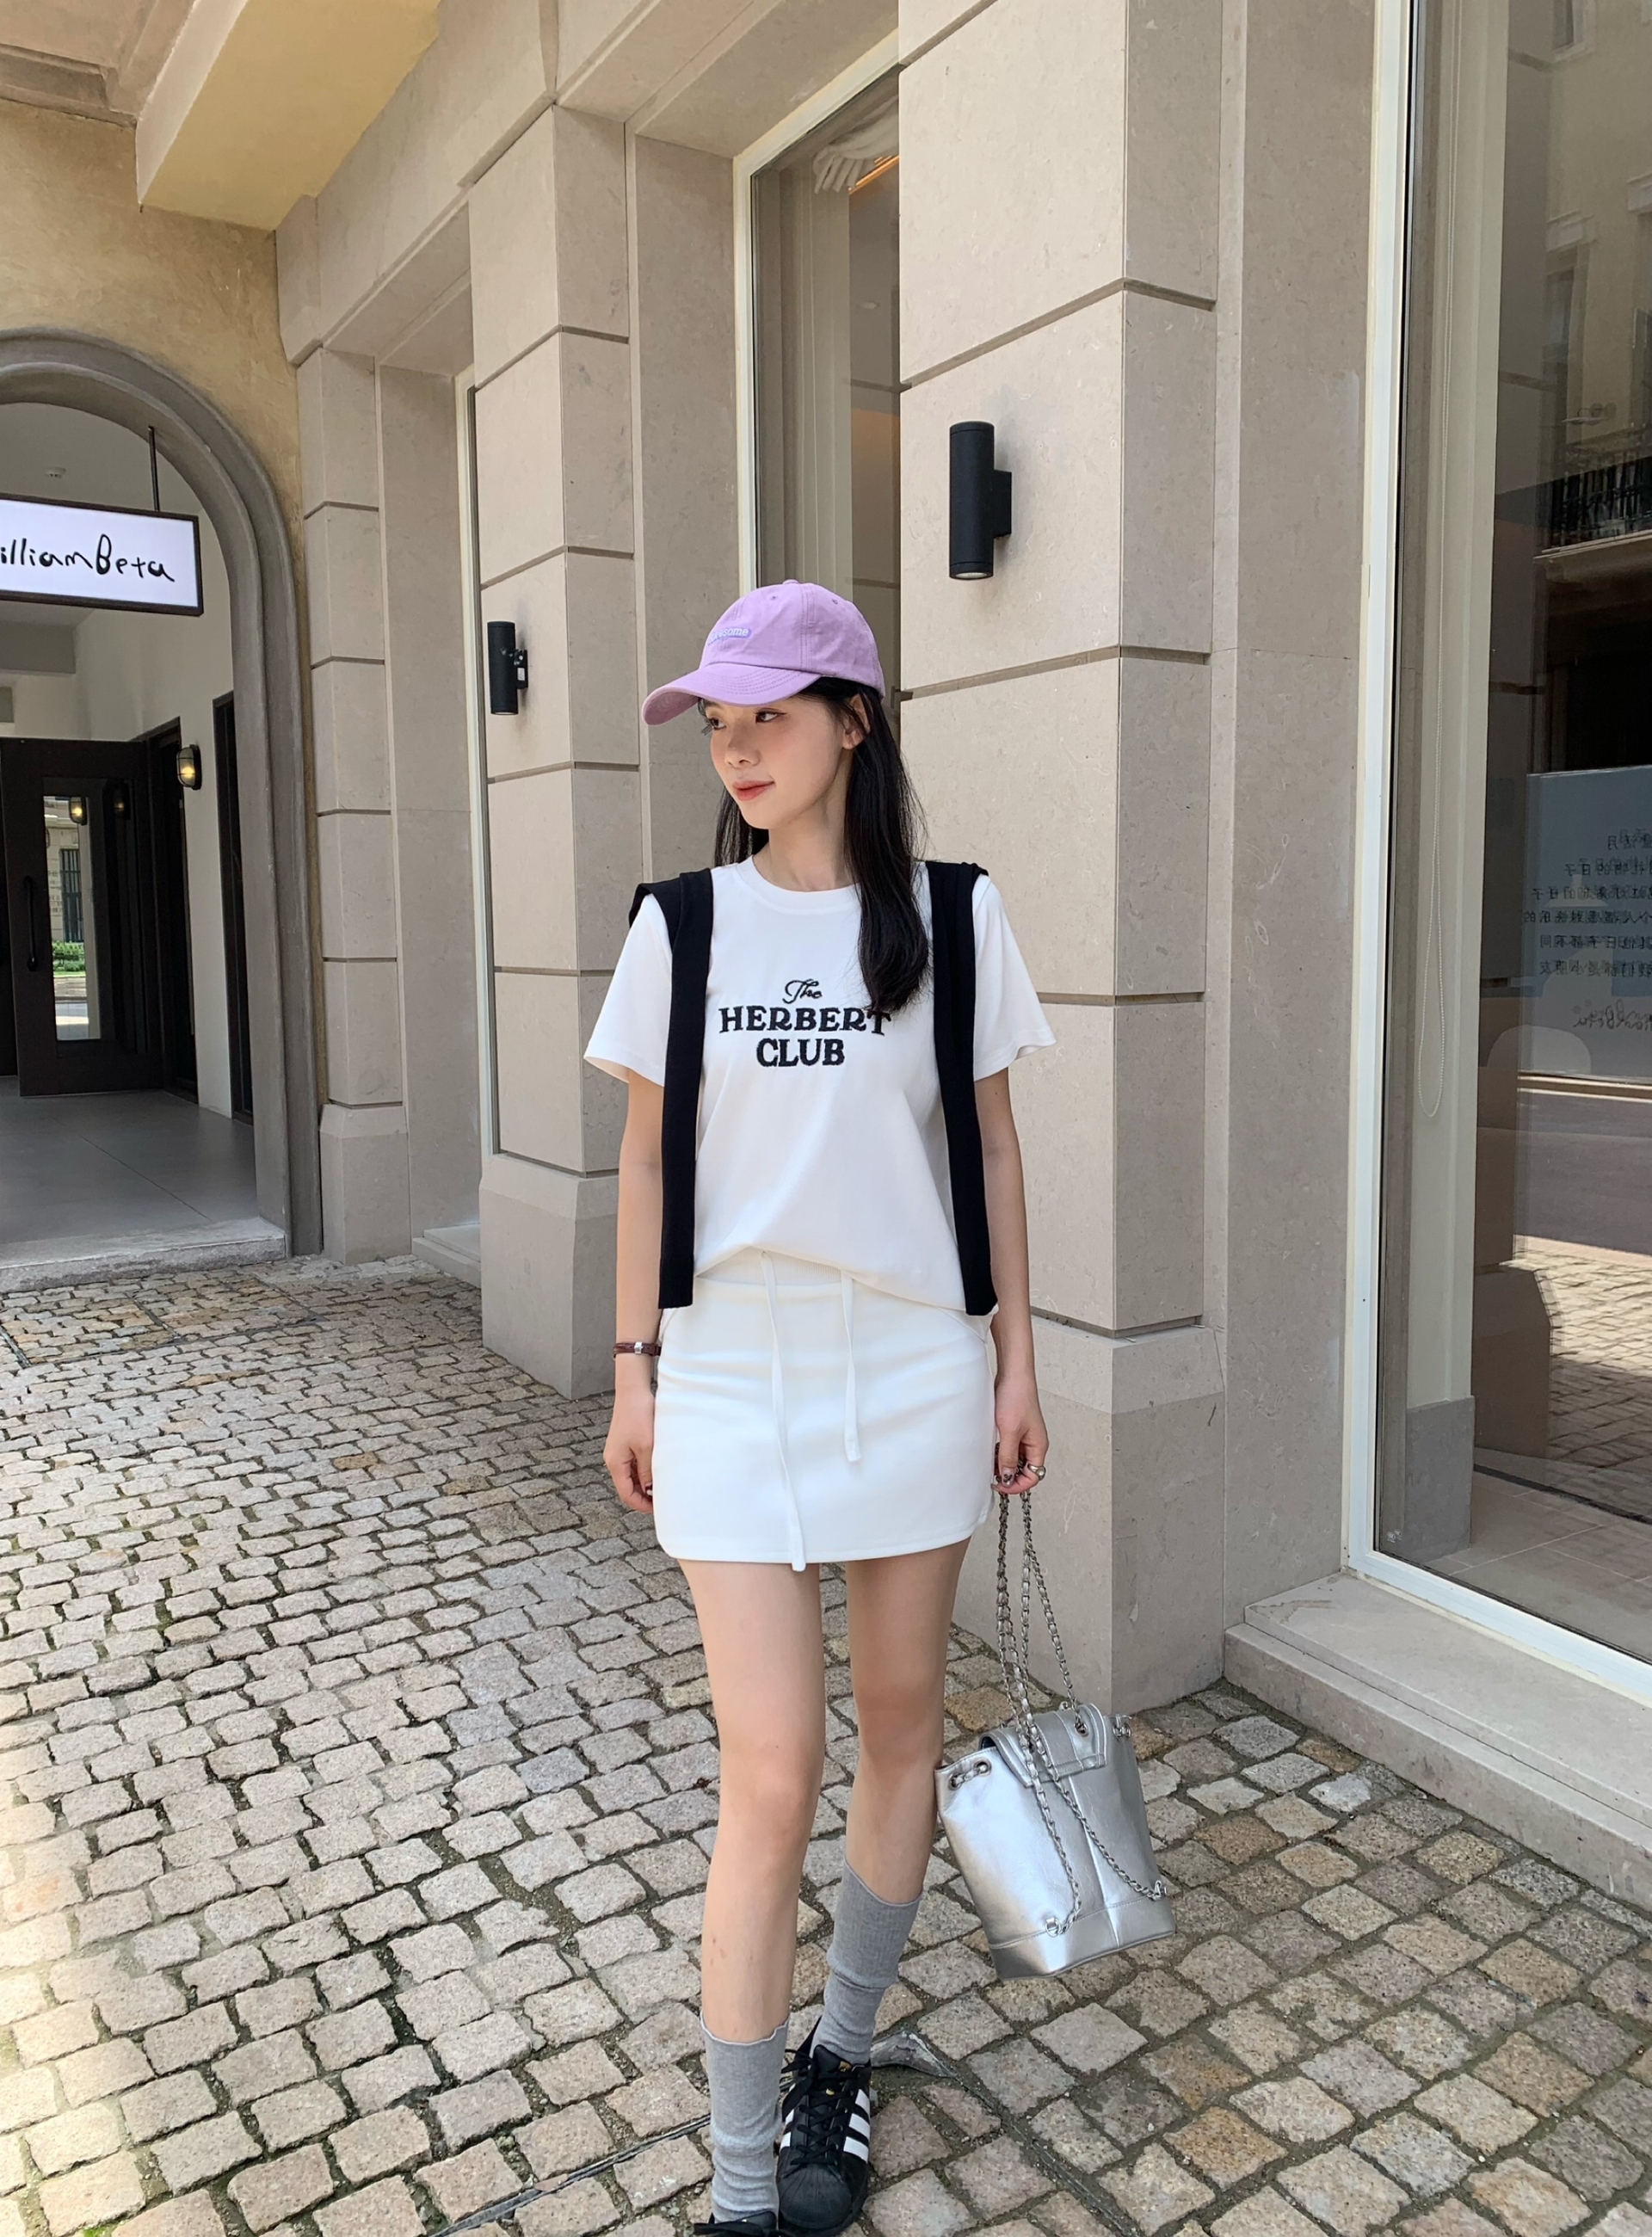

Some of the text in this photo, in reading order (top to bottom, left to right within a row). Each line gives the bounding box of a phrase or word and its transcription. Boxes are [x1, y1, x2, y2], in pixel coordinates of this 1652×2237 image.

[782, 978, 823, 1004] The
[718, 1005, 891, 1036] HERBERT
[755, 1038, 845, 1068] CLUB
